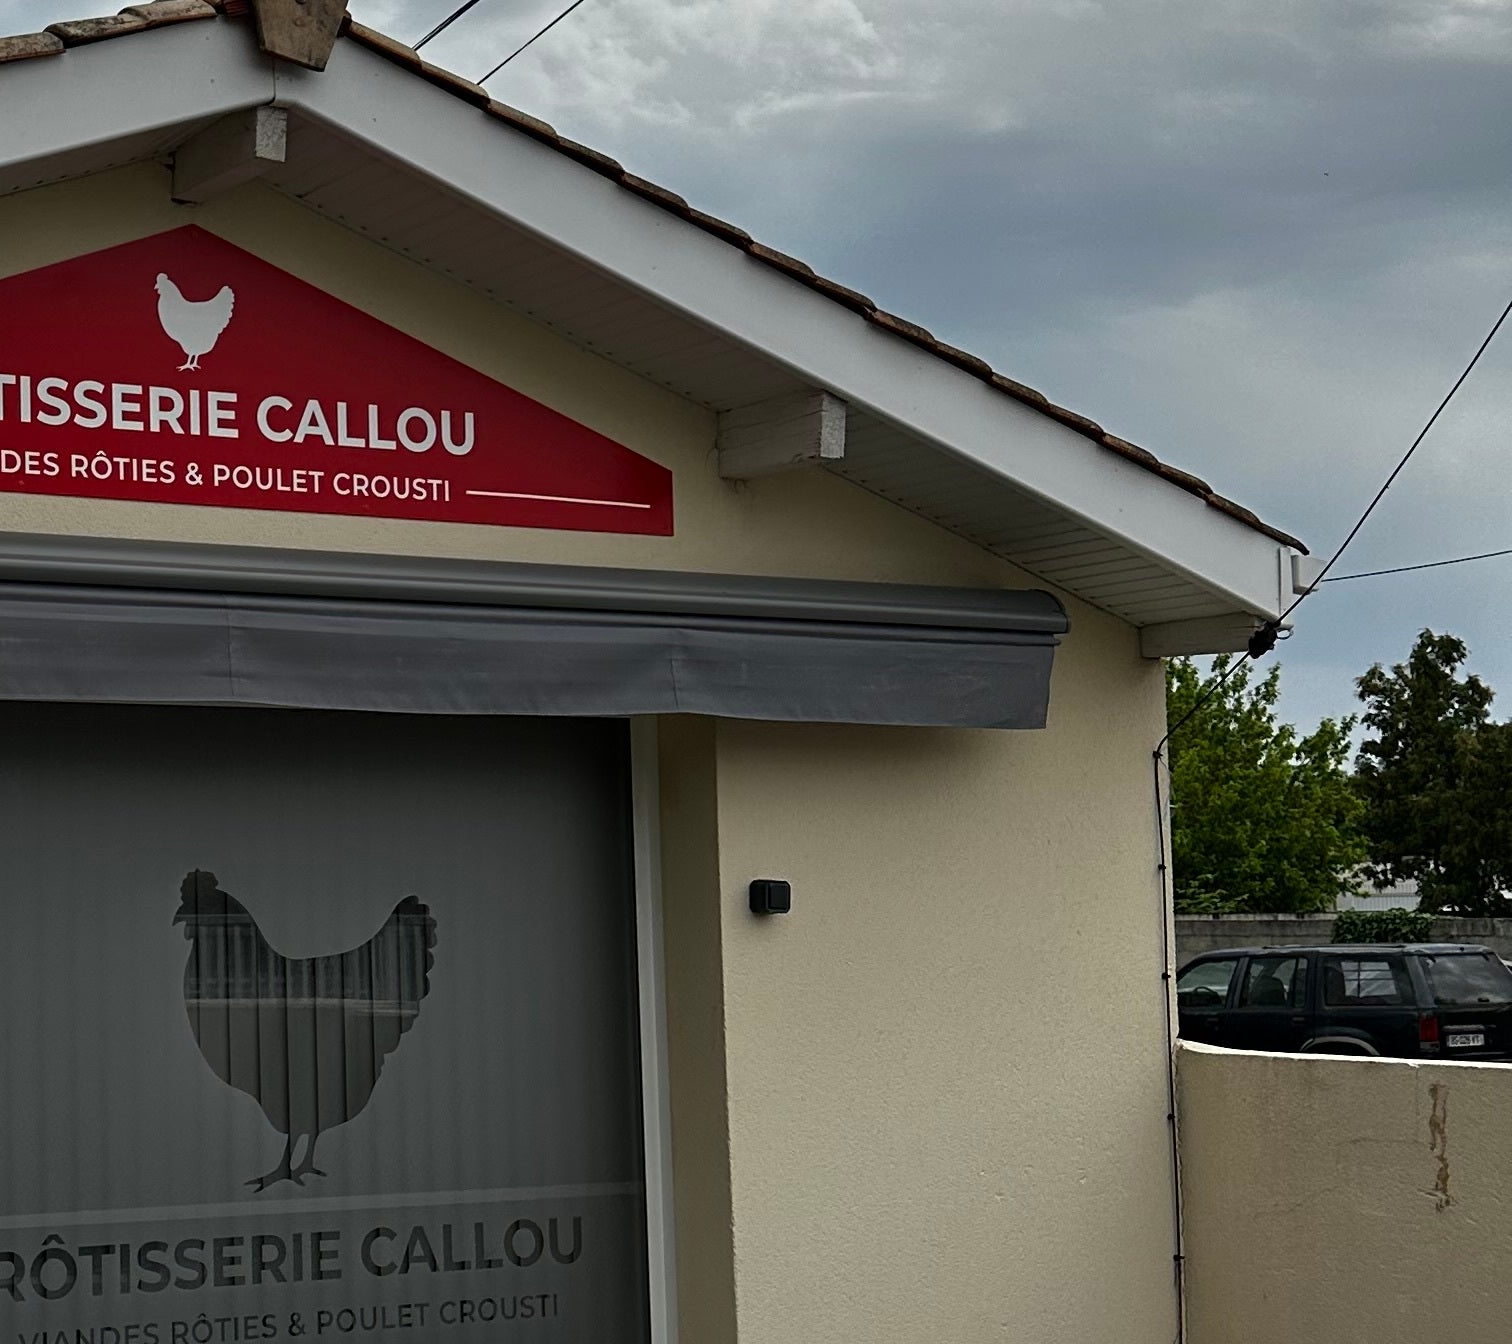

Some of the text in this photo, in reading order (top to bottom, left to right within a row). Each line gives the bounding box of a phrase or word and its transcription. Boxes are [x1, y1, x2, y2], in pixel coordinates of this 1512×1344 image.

[257, 396, 476, 456] CALLOU
[70, 450, 176, 484] RÔTIES
[185, 462, 204, 486] &
[213, 463, 325, 494] POULET
[333, 472, 450, 502] CROUSTI
[360, 1216, 582, 1276] CALLOU
[289, 1312, 305, 1336] &
[317, 1303, 430, 1335] POULET
[439, 1294, 557, 1326] CROUSTI
